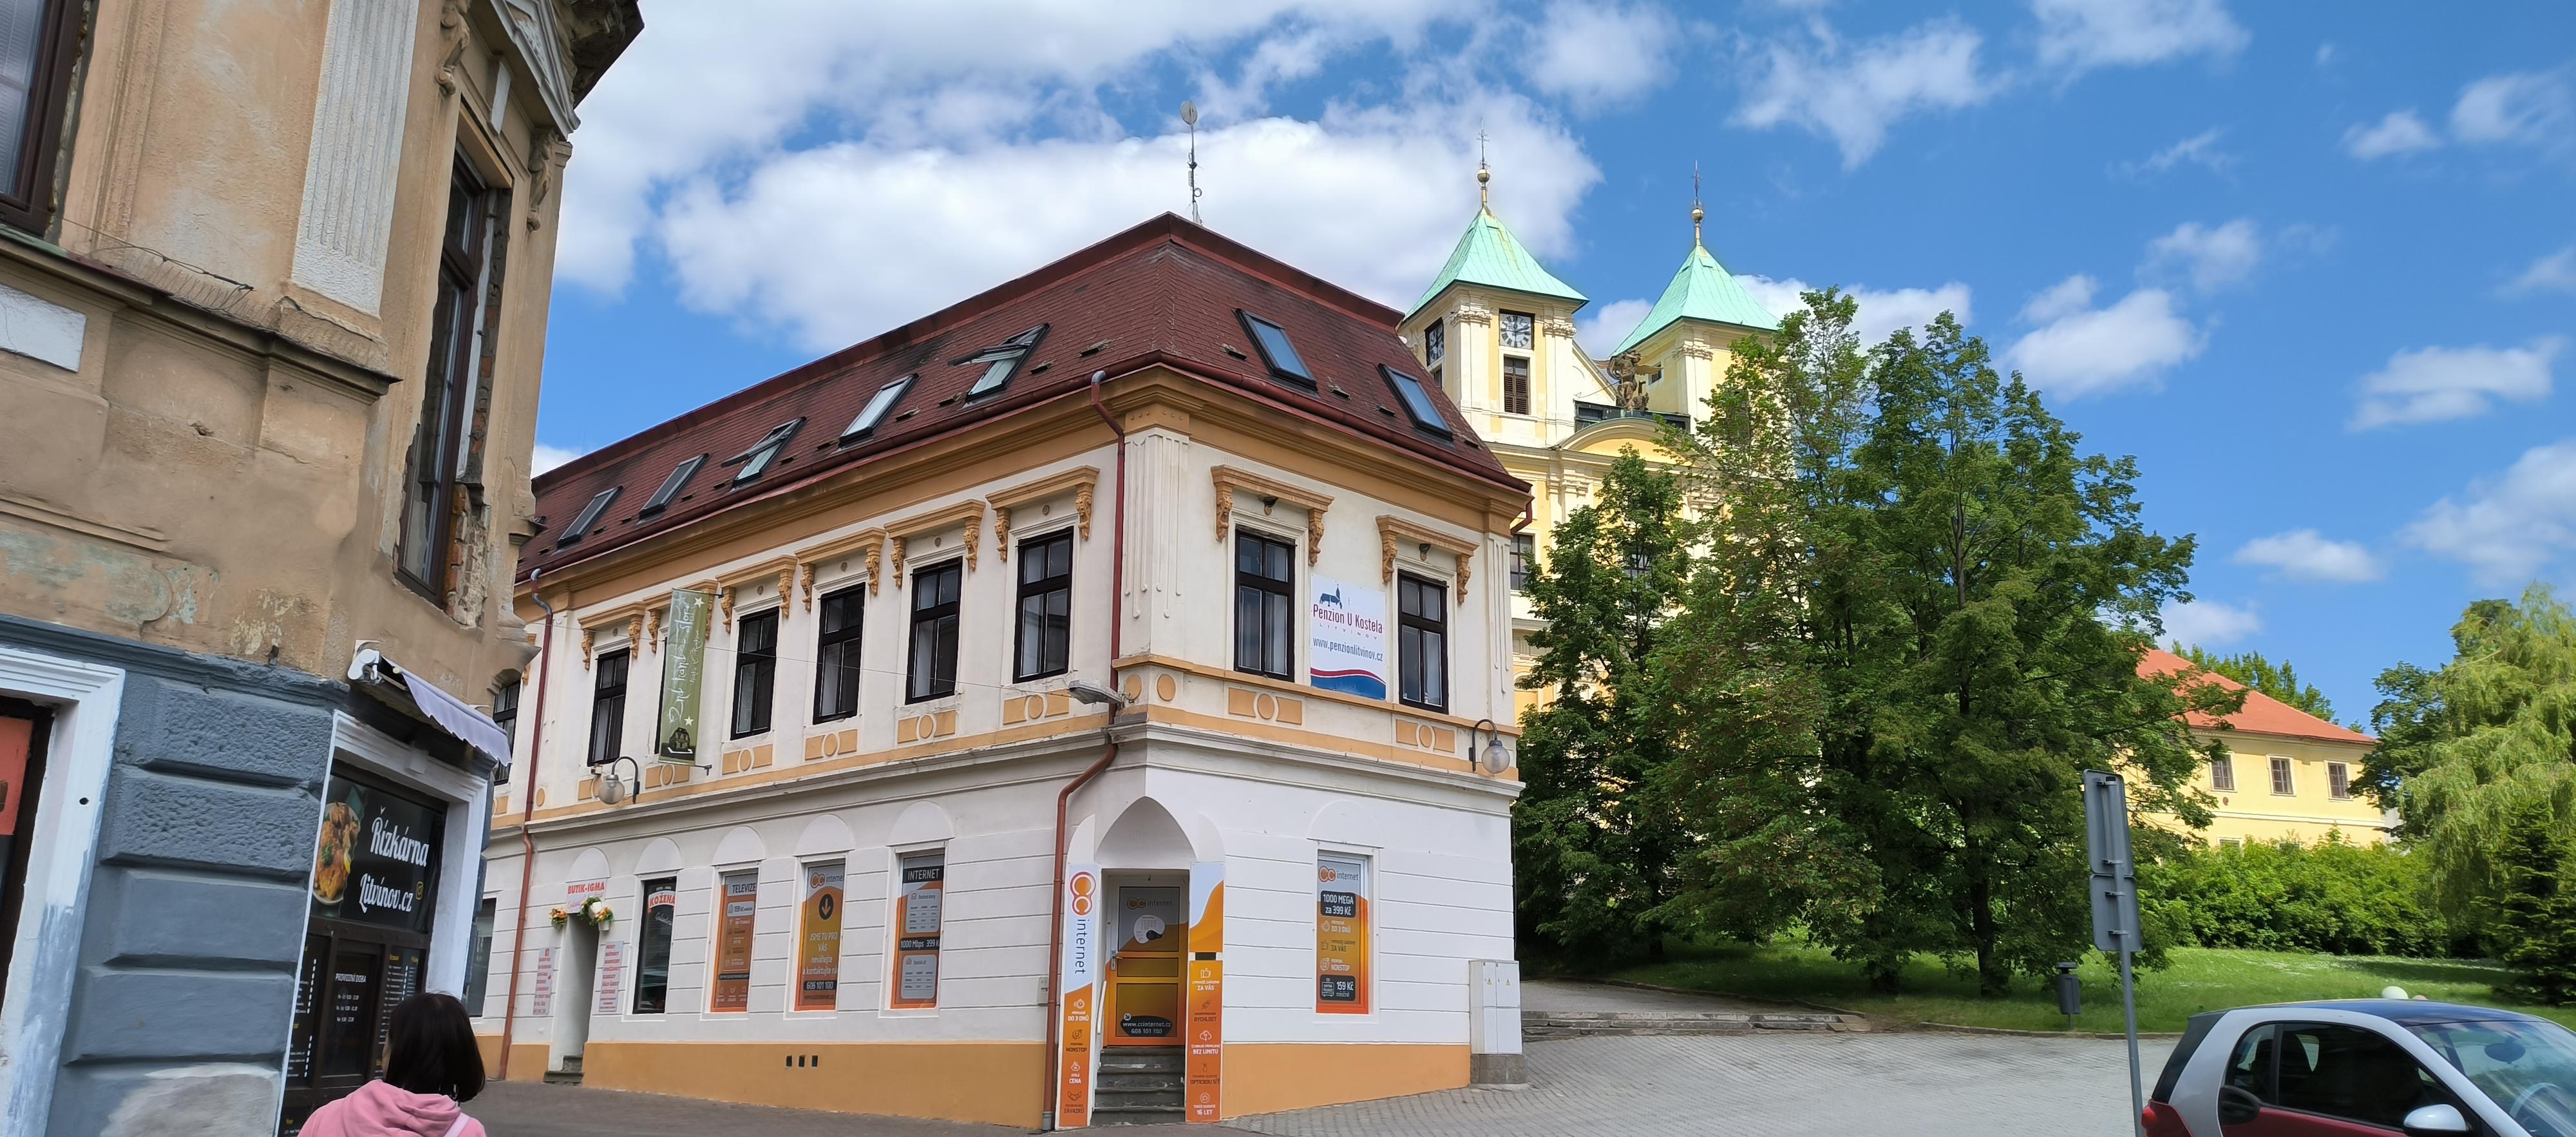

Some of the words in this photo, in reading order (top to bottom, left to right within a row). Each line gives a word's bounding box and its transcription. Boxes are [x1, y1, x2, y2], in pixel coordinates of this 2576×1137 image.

[1313, 604, 1345, 624] Penzion
[1347, 612, 1352, 626] U
[1355, 614, 1383, 634] Kostela
[1313, 638, 1383, 662] www.penzionlitvinov.cz
[370, 805, 430, 867] Řízkárna
[907, 868, 940, 881] INTERNET
[1337, 870, 1359, 881] internet
[359, 873, 414, 913] Litvínov.cz
[732, 883, 756, 893] TELEVIZE
[1323, 893, 1338, 903] 1000
[1338, 895, 1354, 904] MEGA
[1332, 906, 1343, 915] 399
[1345, 906, 1351, 915] Kč
[810, 933, 822, 941] JSME
[822, 932, 828, 941] TU
[818, 942, 828, 951] VÁS
[900, 940, 912, 948] 1000
[912, 940, 924, 949] Mbps
[926, 939, 935, 947] 399
[1075, 919, 1090, 975] internet
[806, 981, 816, 989] 606
[825, 981, 833, 989] 100
[1336, 981, 1346, 990] 159
[1347, 981, 1354, 991] Kč
